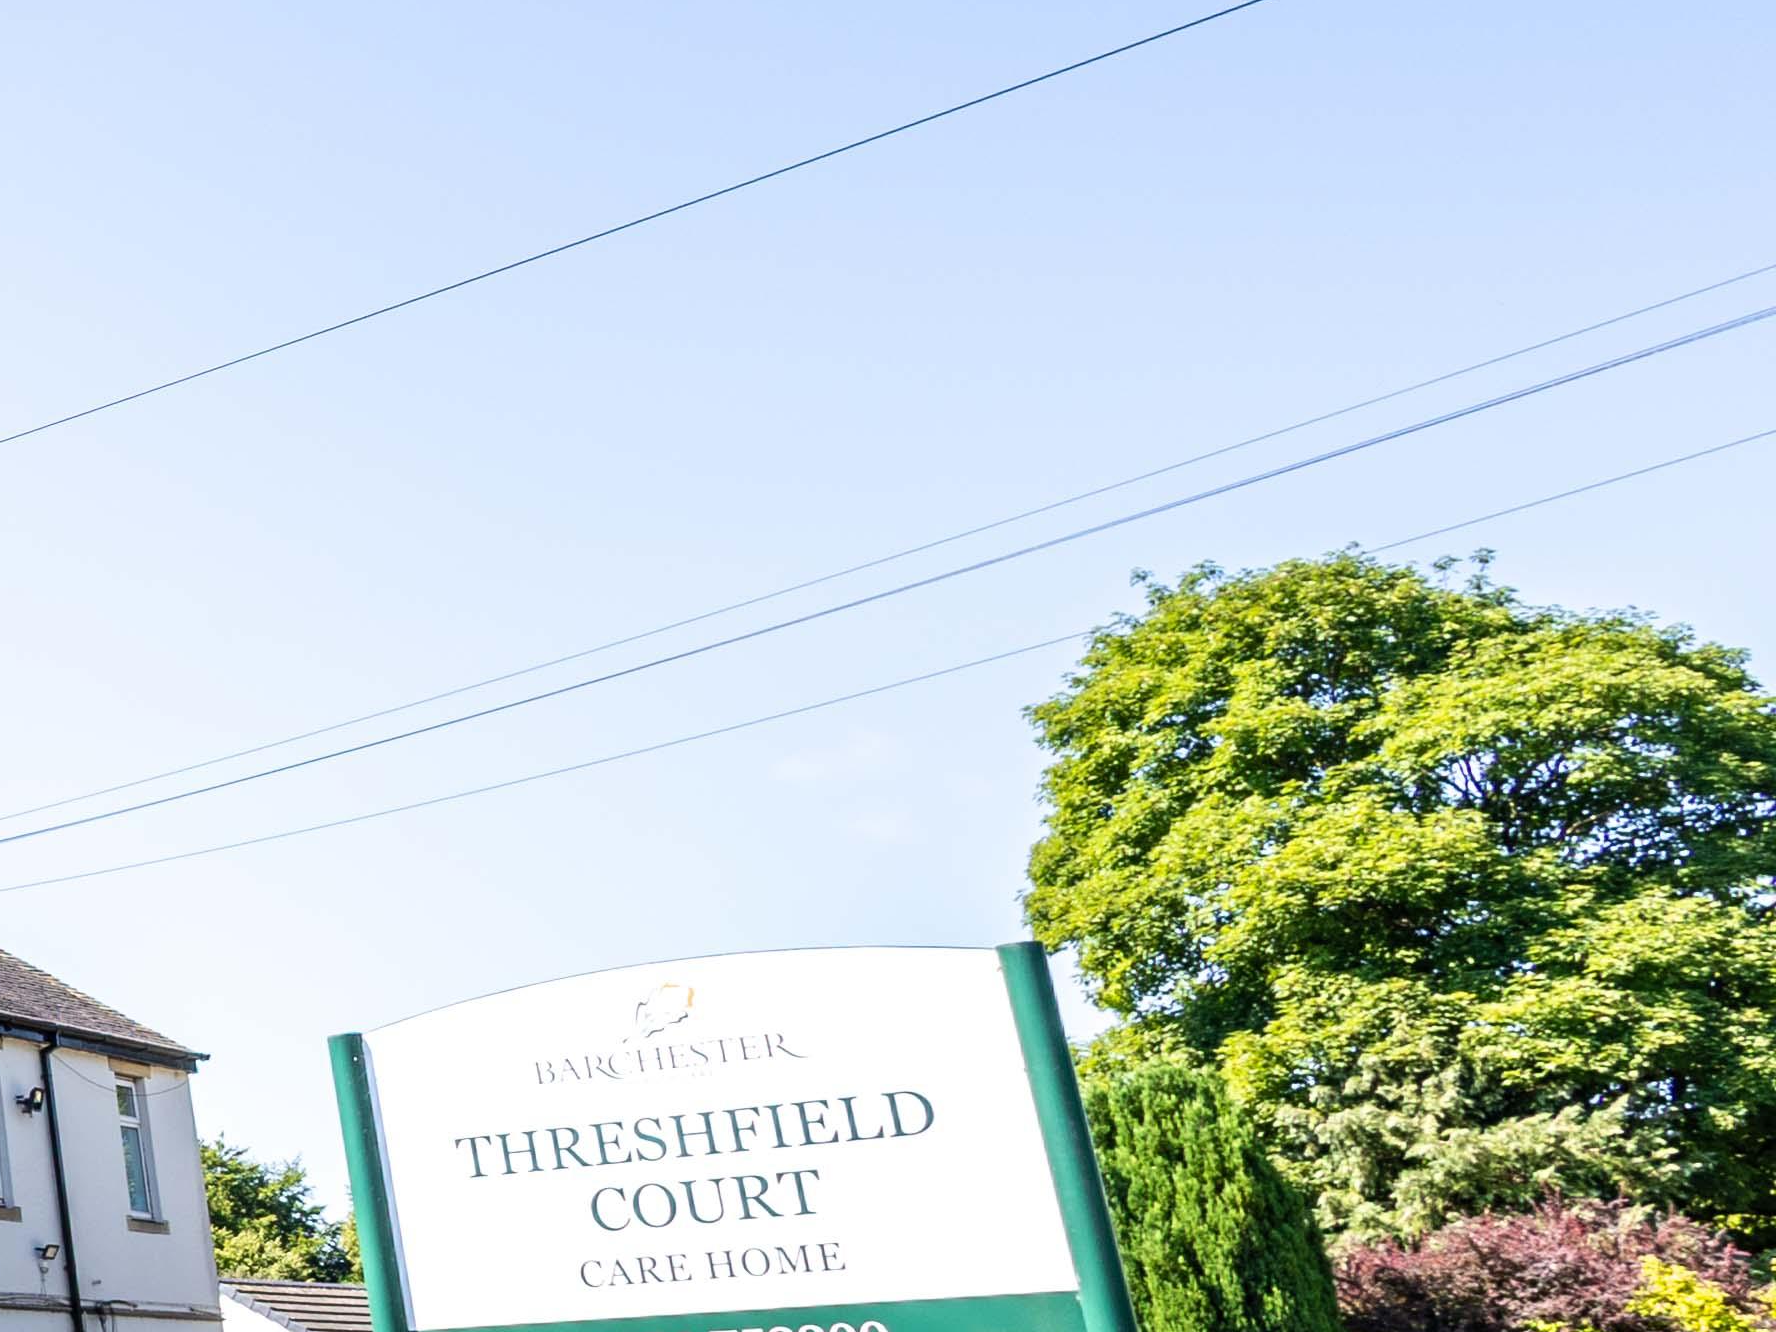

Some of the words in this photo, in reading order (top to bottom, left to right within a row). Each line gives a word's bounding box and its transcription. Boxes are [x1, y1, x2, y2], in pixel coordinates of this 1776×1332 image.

[535, 1032, 809, 1085] BARCHESTER
[454, 1089, 935, 1178] THRESHFIELD
[590, 1169, 821, 1232] COURT
[579, 1253, 693, 1288] CARE
[706, 1242, 846, 1279] HOME
